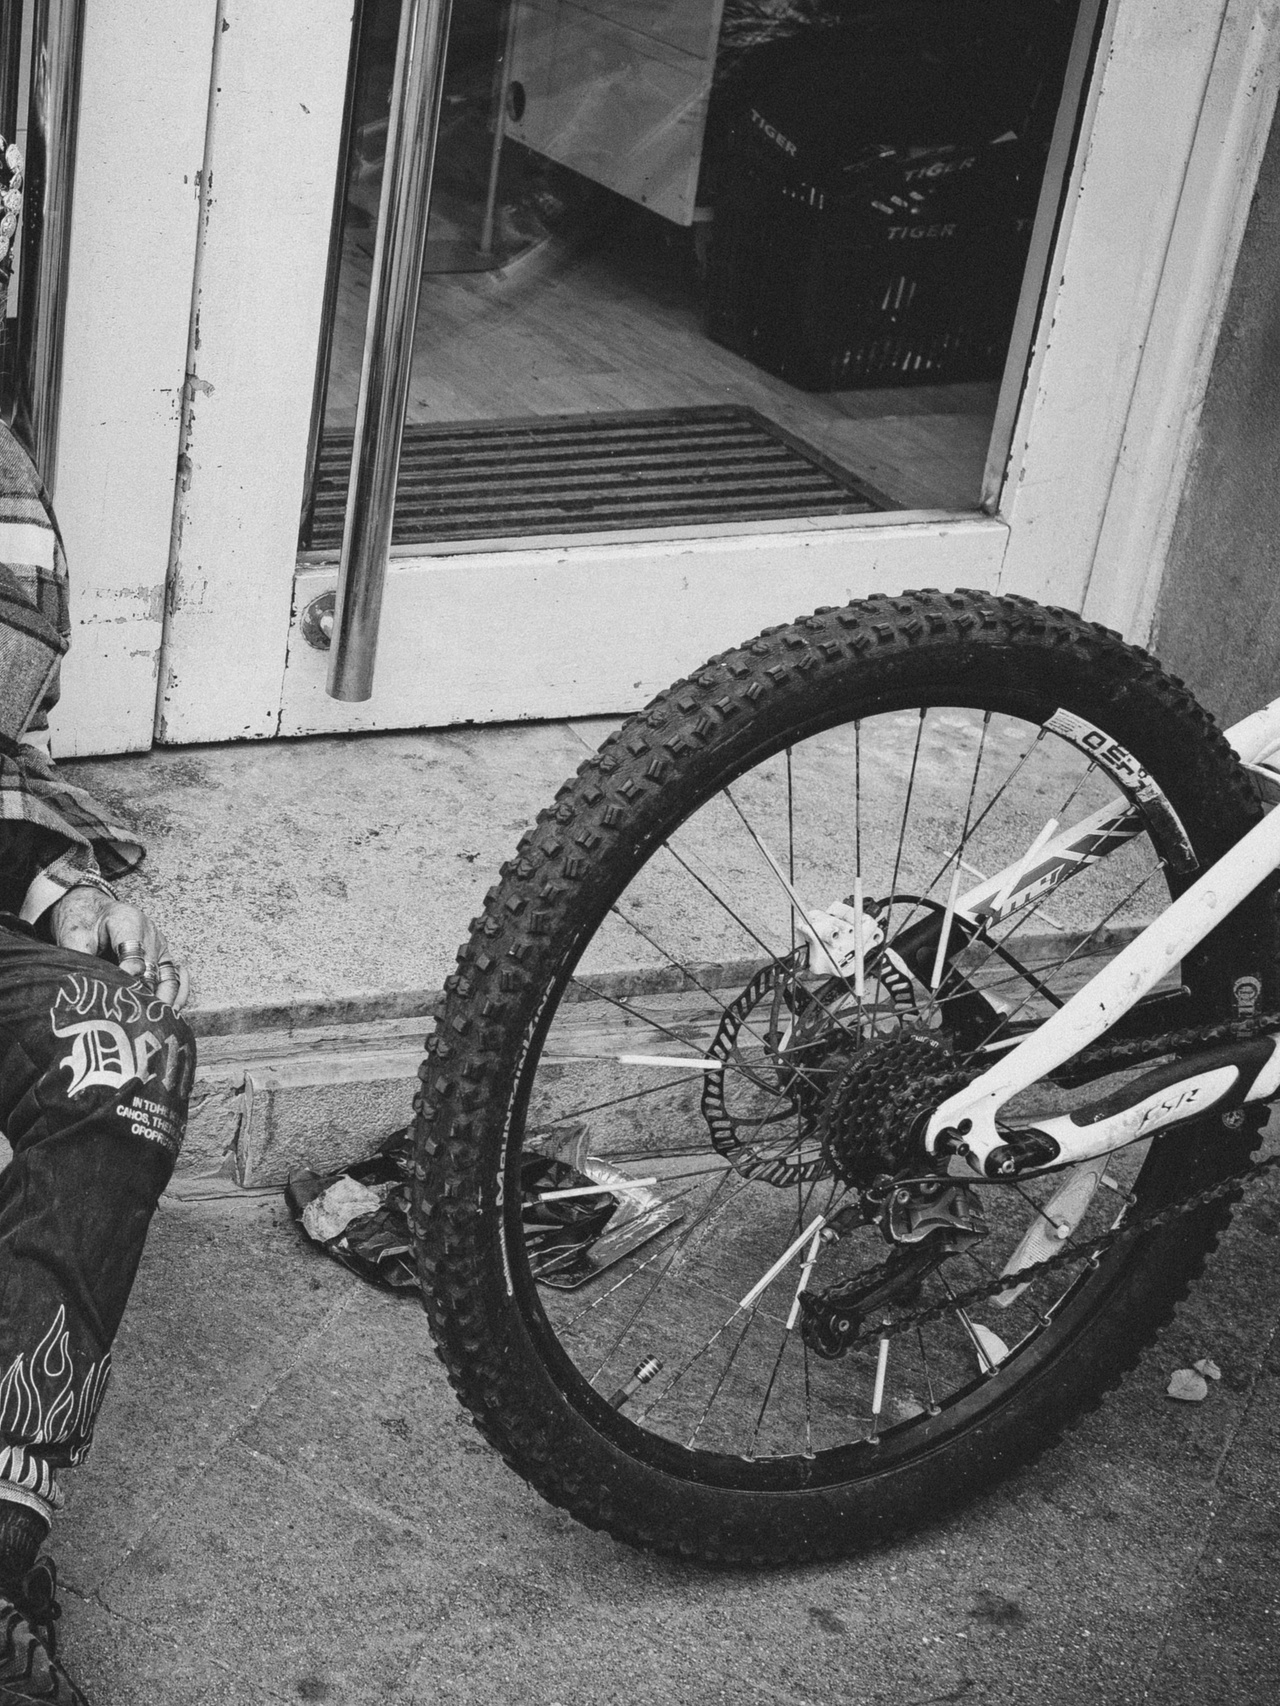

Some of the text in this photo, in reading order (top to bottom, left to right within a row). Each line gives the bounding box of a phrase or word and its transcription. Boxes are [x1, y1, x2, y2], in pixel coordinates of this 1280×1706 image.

[751, 108, 797, 157] TIGER
[888, 223, 958, 240] TIGER
[132, 1096, 143, 1109] IN
[116, 1104, 151, 1127] CAHOS,
